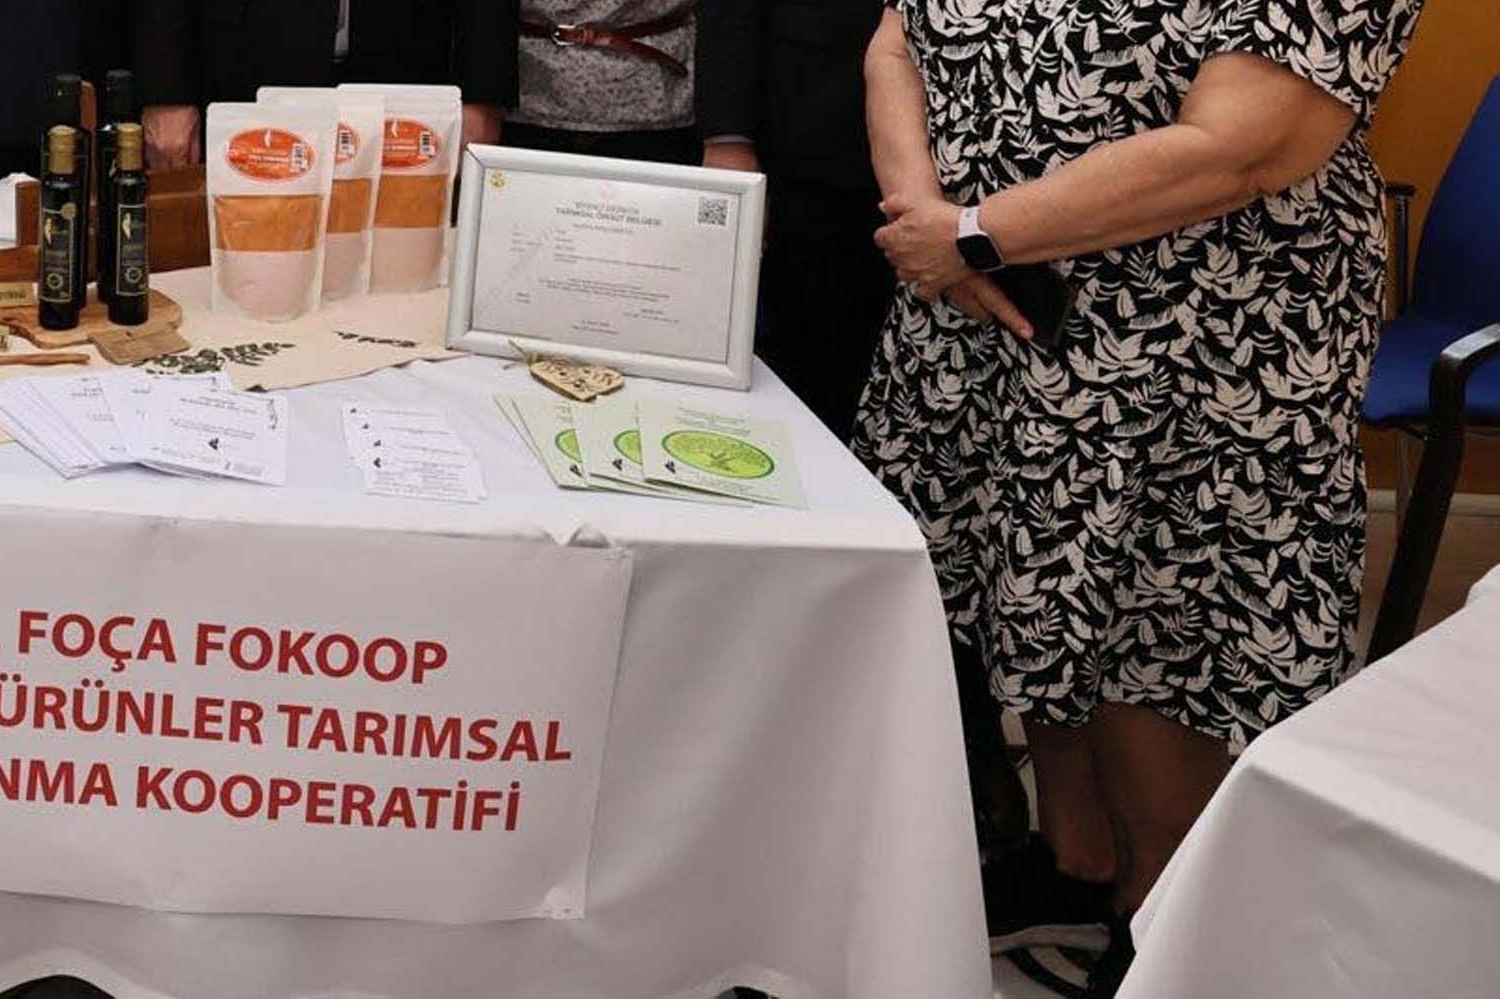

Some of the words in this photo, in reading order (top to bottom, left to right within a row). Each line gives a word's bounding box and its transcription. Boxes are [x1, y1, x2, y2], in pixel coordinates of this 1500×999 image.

[18, 609, 177, 672] FOÇA
[195, 621, 449, 684] FOKOOP
[278, 702, 574, 763] TARIMSAL
[136, 765, 521, 831] KOOPERATİFİ
